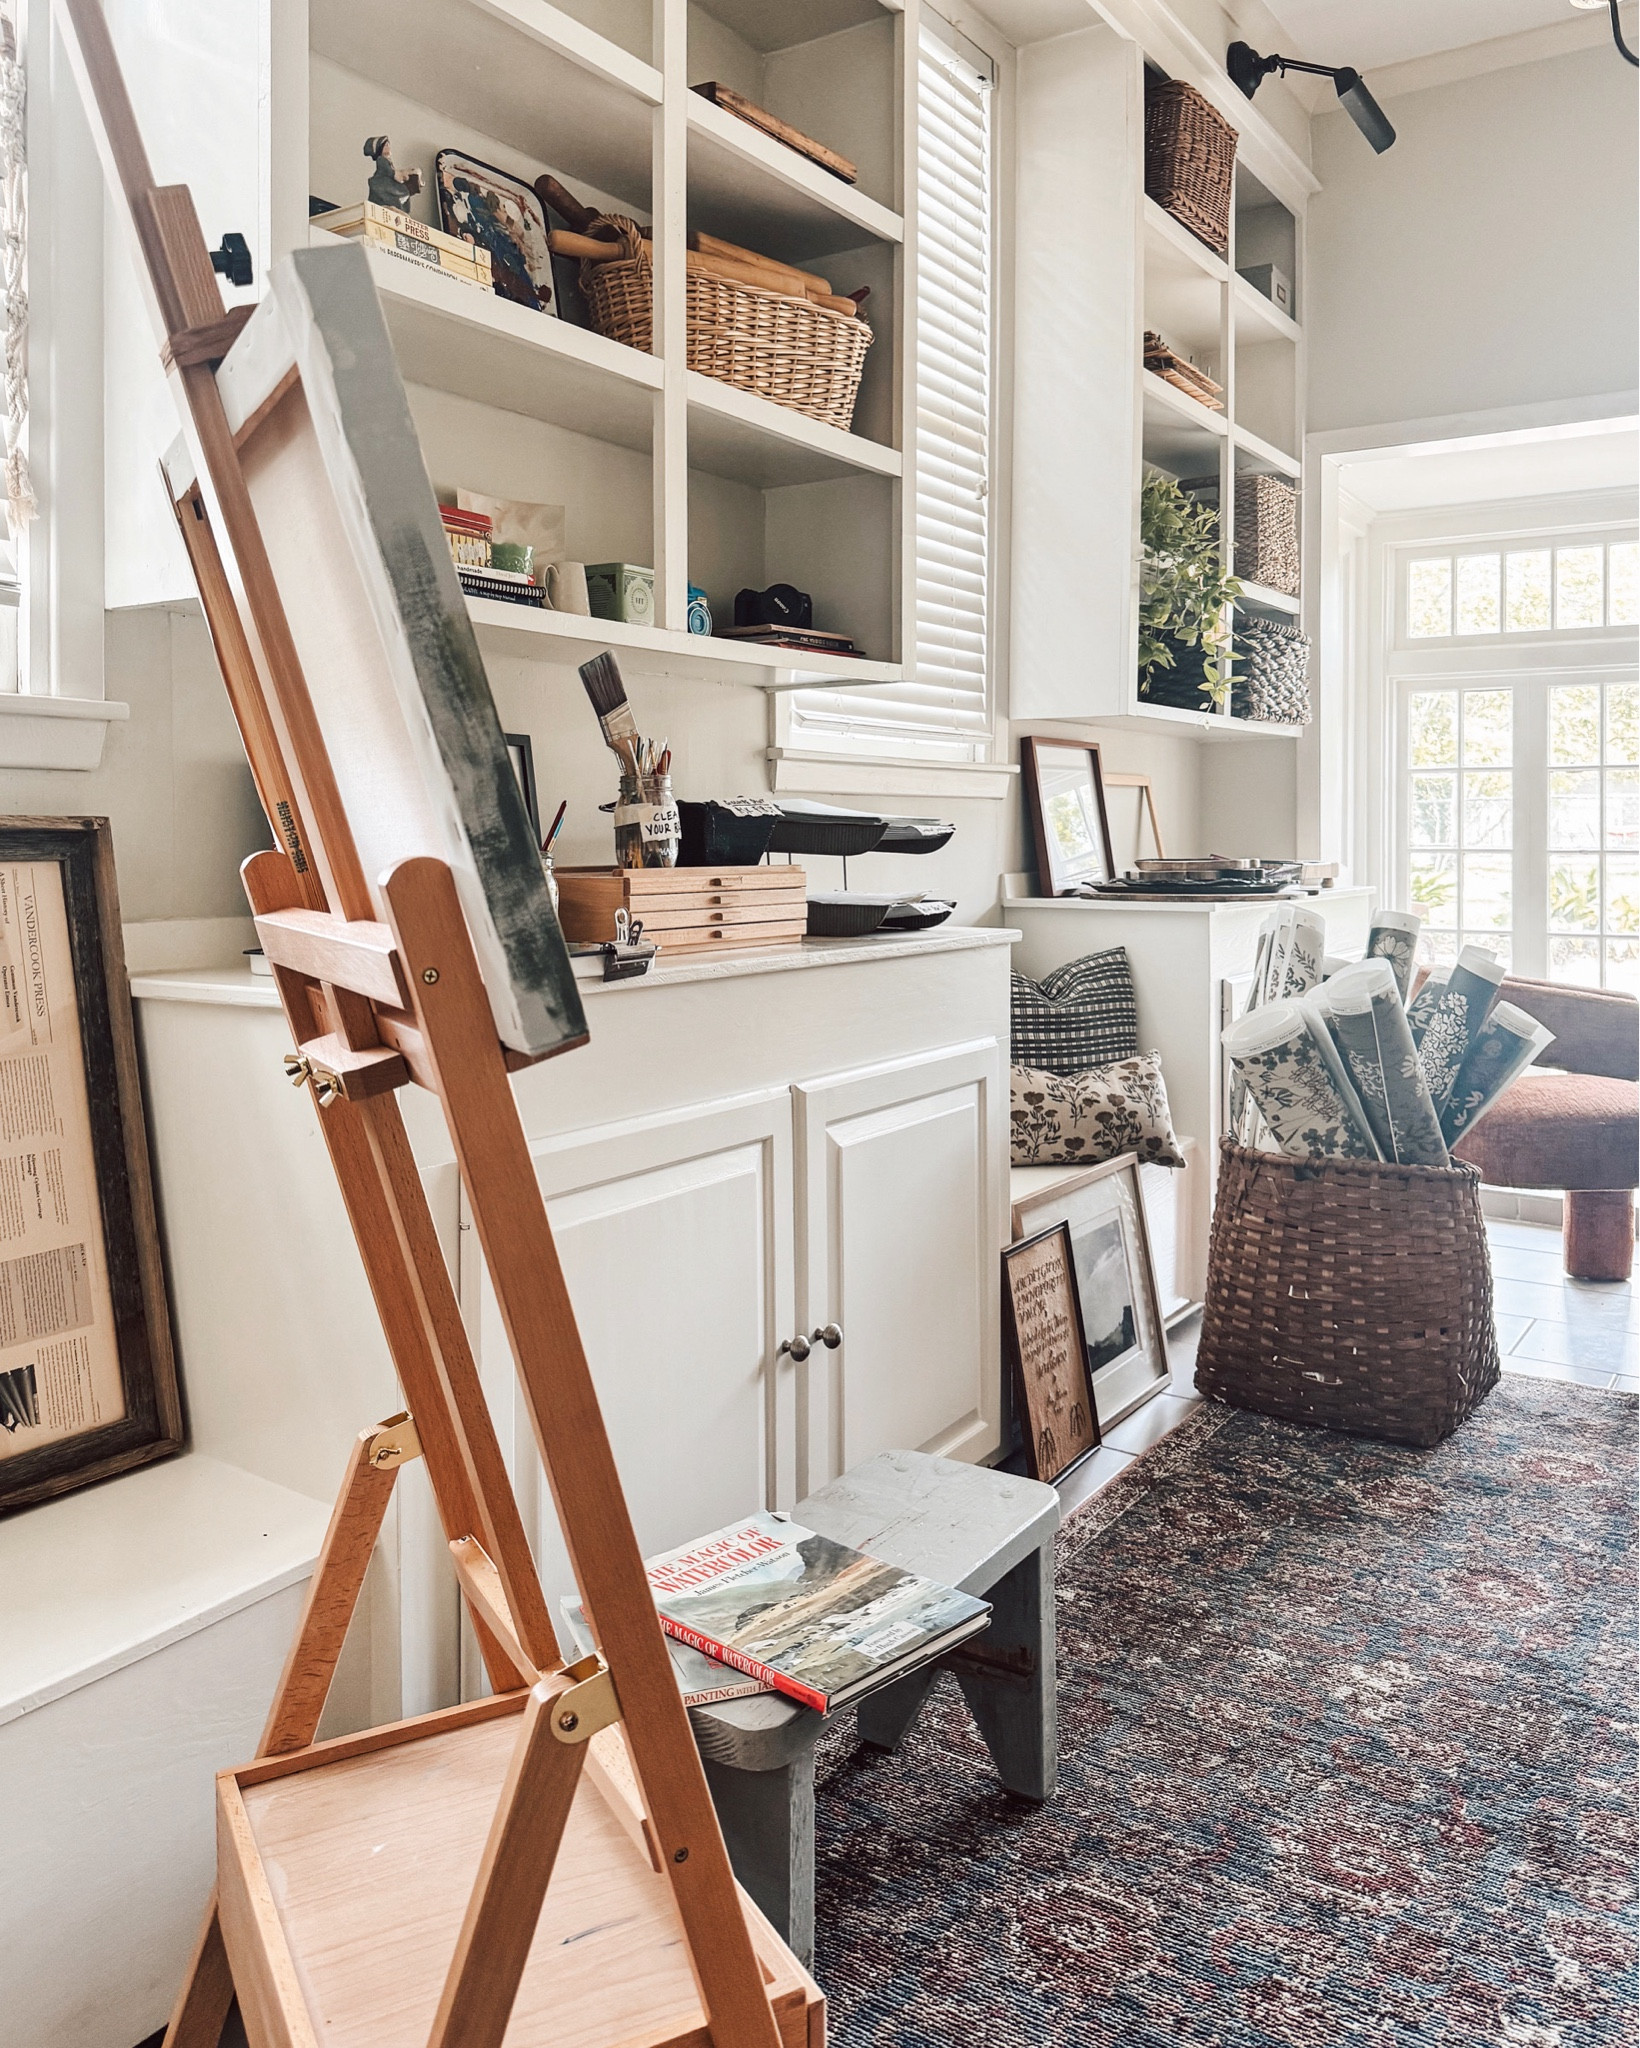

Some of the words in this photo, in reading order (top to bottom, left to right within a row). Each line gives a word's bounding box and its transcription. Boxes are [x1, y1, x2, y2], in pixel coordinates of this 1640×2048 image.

[405, 223, 430, 241] PRESS
[774, 597, 789, 614] Canon
[653, 810, 678, 822] CLEA
[645, 823, 671, 836] YOUR
[24, 895, 42, 980] VANDERCOOK
[34, 982, 46, 1017] PRESS
[647, 1564, 682, 1583] HE
[677, 1538, 740, 1568] MAGIC
[737, 1527, 764, 1542] OF
[653, 1536, 786, 1594] WATERCOLOR
[694, 1581, 725, 1597] James
[660, 1618, 673, 1635] HE
[674, 1625, 704, 1651] MAGIC
[704, 1641, 719, 1657] OF
[722, 1650, 775, 1686] WATERCOLOR
[684, 1687, 735, 1705] PAINTING
[736, 1685, 756, 1695] WITH
